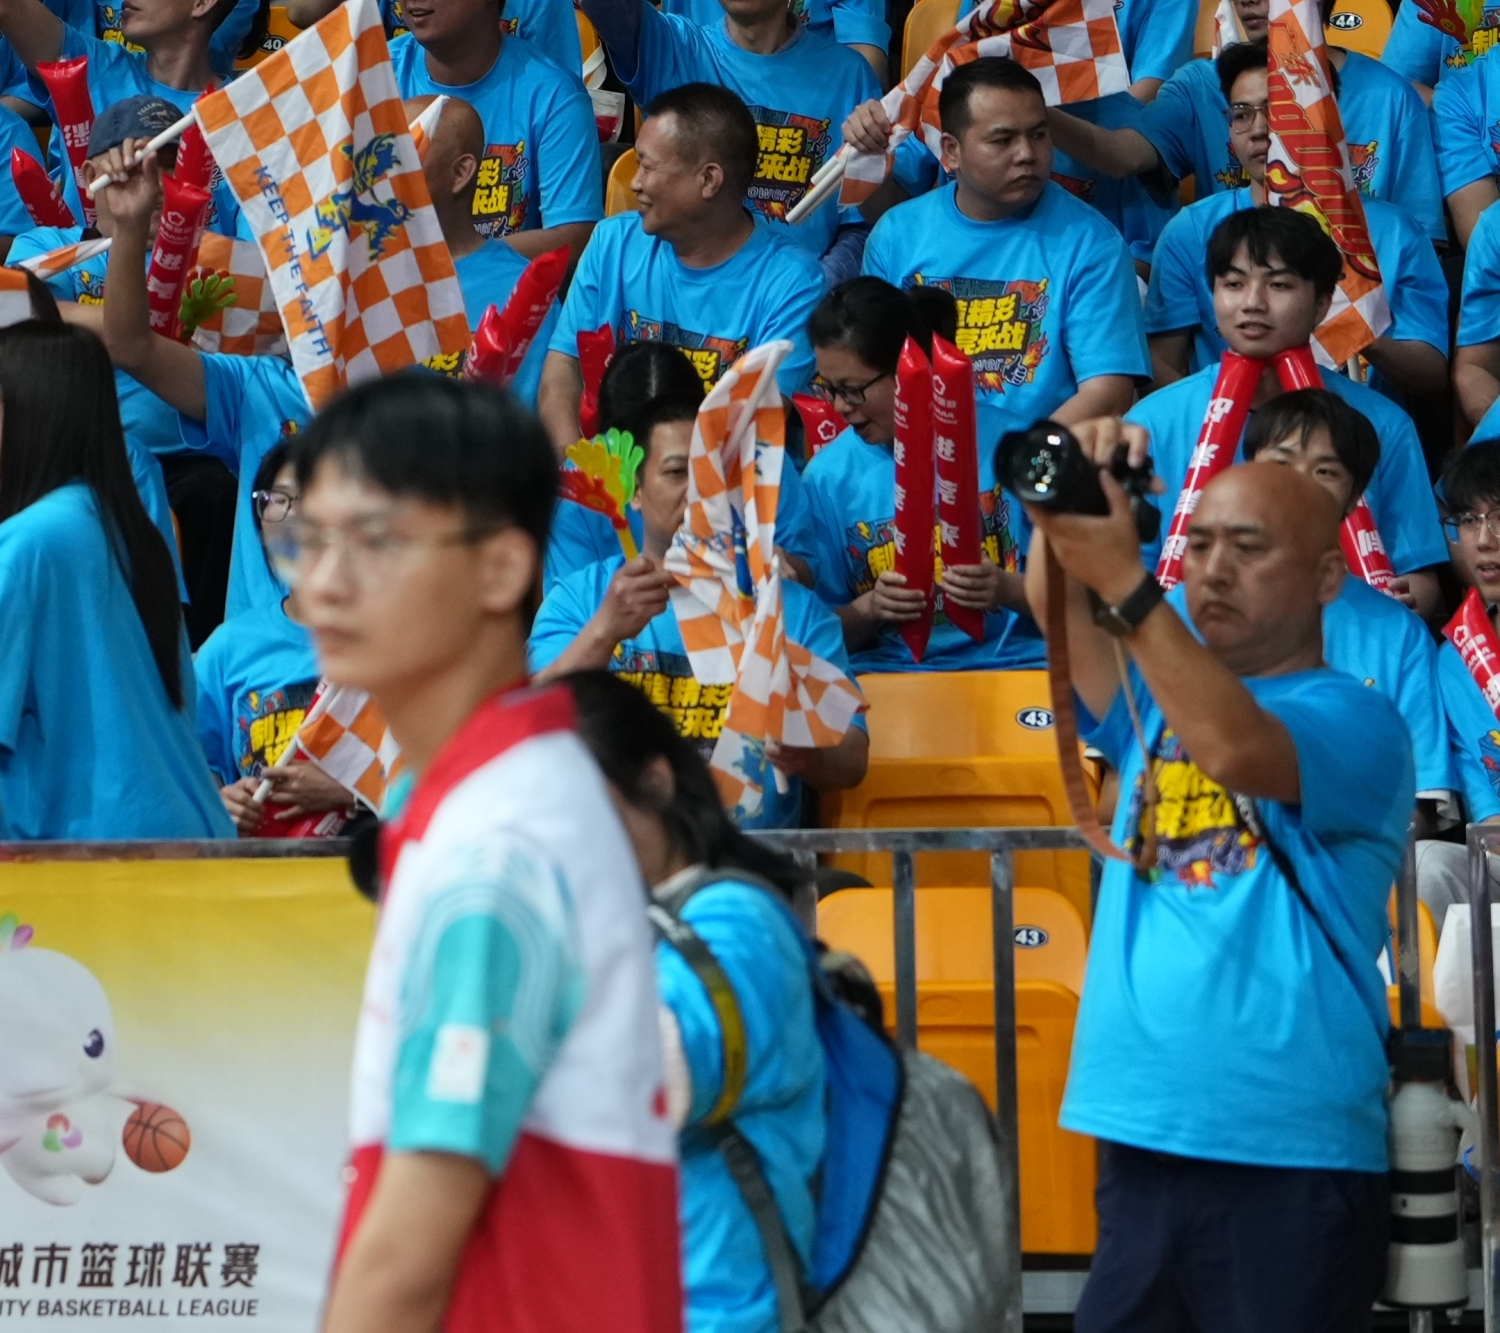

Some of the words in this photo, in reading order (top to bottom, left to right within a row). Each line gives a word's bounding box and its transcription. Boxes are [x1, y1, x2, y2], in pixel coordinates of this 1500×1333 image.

[1336, 16, 1356, 27] 44
[263, 40, 282, 50] 40
[253, 165, 297, 231] KEEP
[292, 276, 333, 358] FAITH
[1025, 712, 1047, 726] 43
[1015, 928, 1040, 945] 43
[36, 1298, 170, 1318] BASKETBALL
[175, 1298, 259, 1318] LEAGUE
